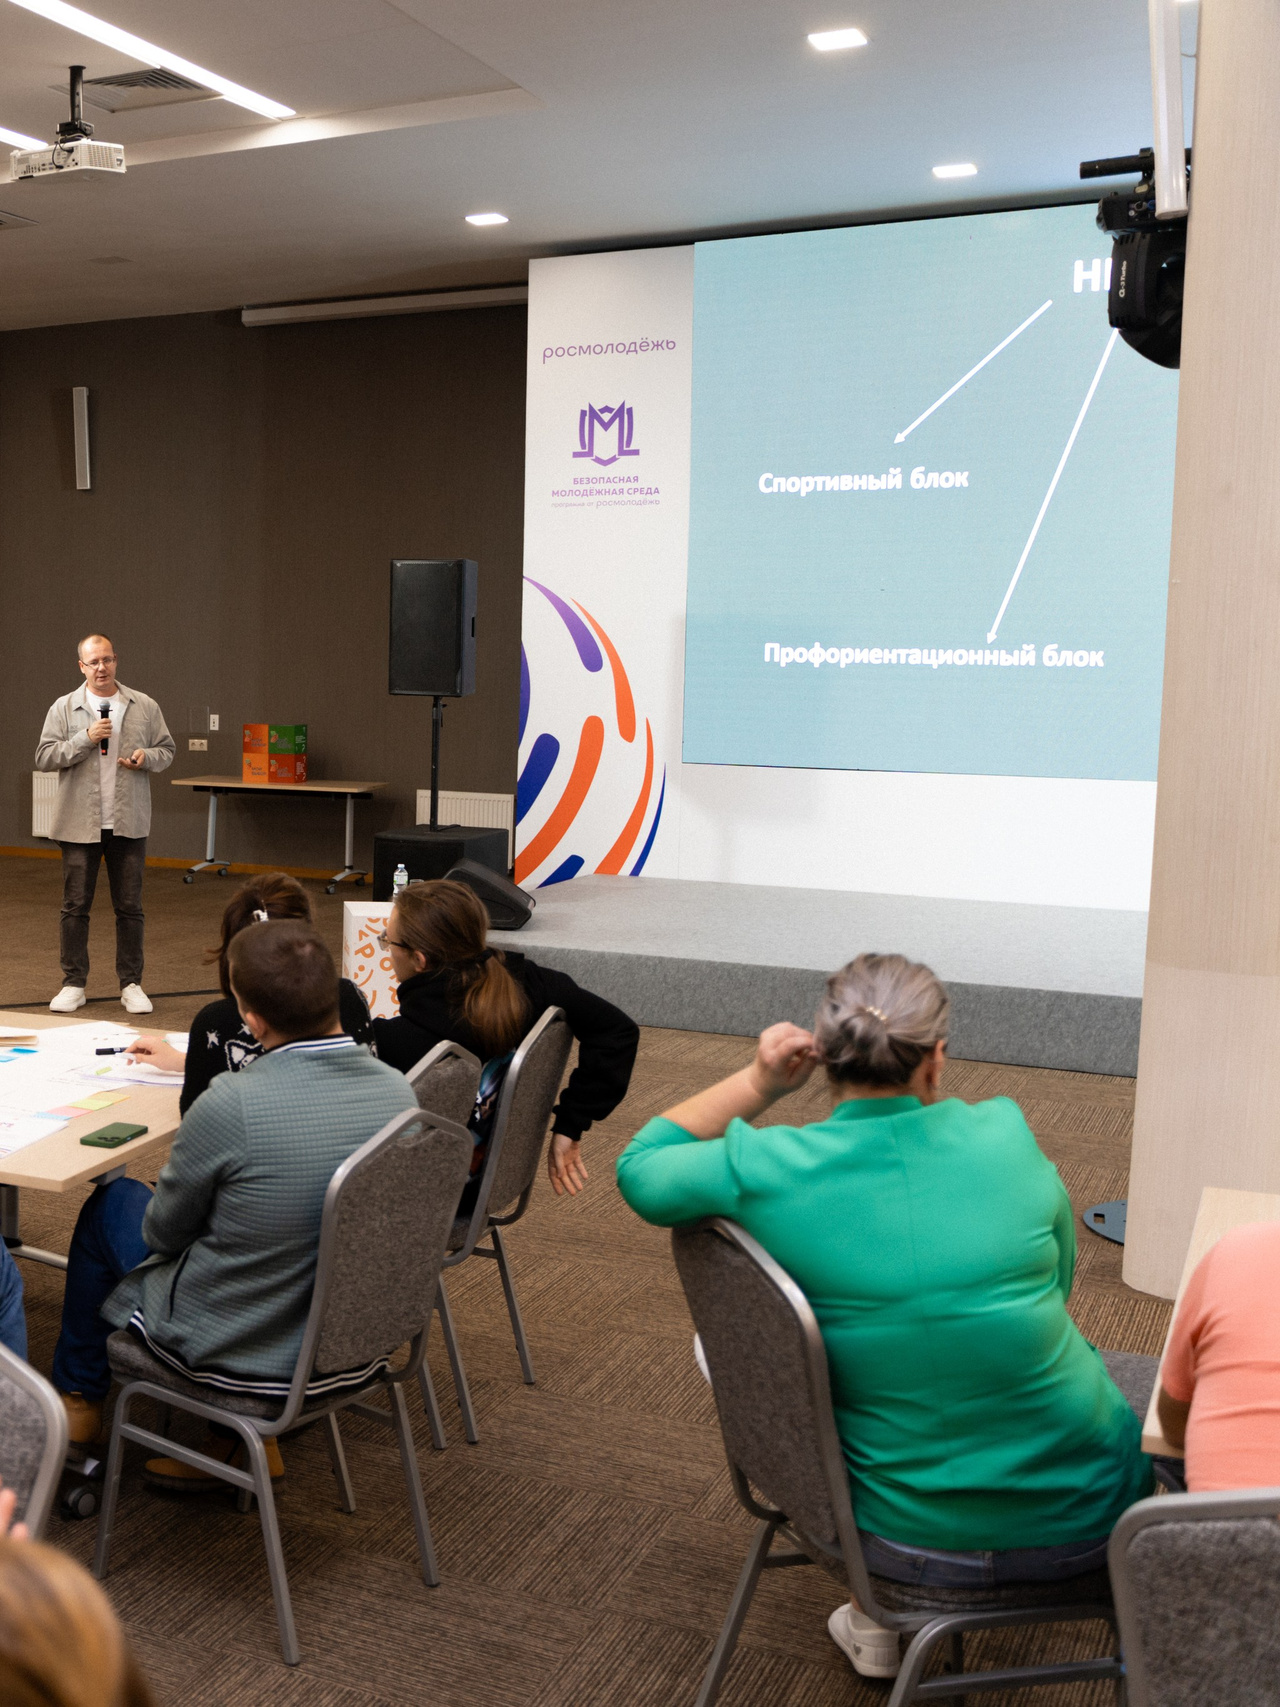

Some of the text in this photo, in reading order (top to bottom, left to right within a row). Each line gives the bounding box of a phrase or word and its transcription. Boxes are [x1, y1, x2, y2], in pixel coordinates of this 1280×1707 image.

[542, 337, 677, 365] росмолодёжь
[572, 475, 639, 486] БЕЗОПАСНАЯ
[757, 465, 970, 497] Спортивный блок
[551, 487, 661, 498] МОЛОДЁЖНАЯ СРЕДА
[595, 497, 661, 509] росмолодёжь
[763, 641, 1106, 670] Профориентационный блок
